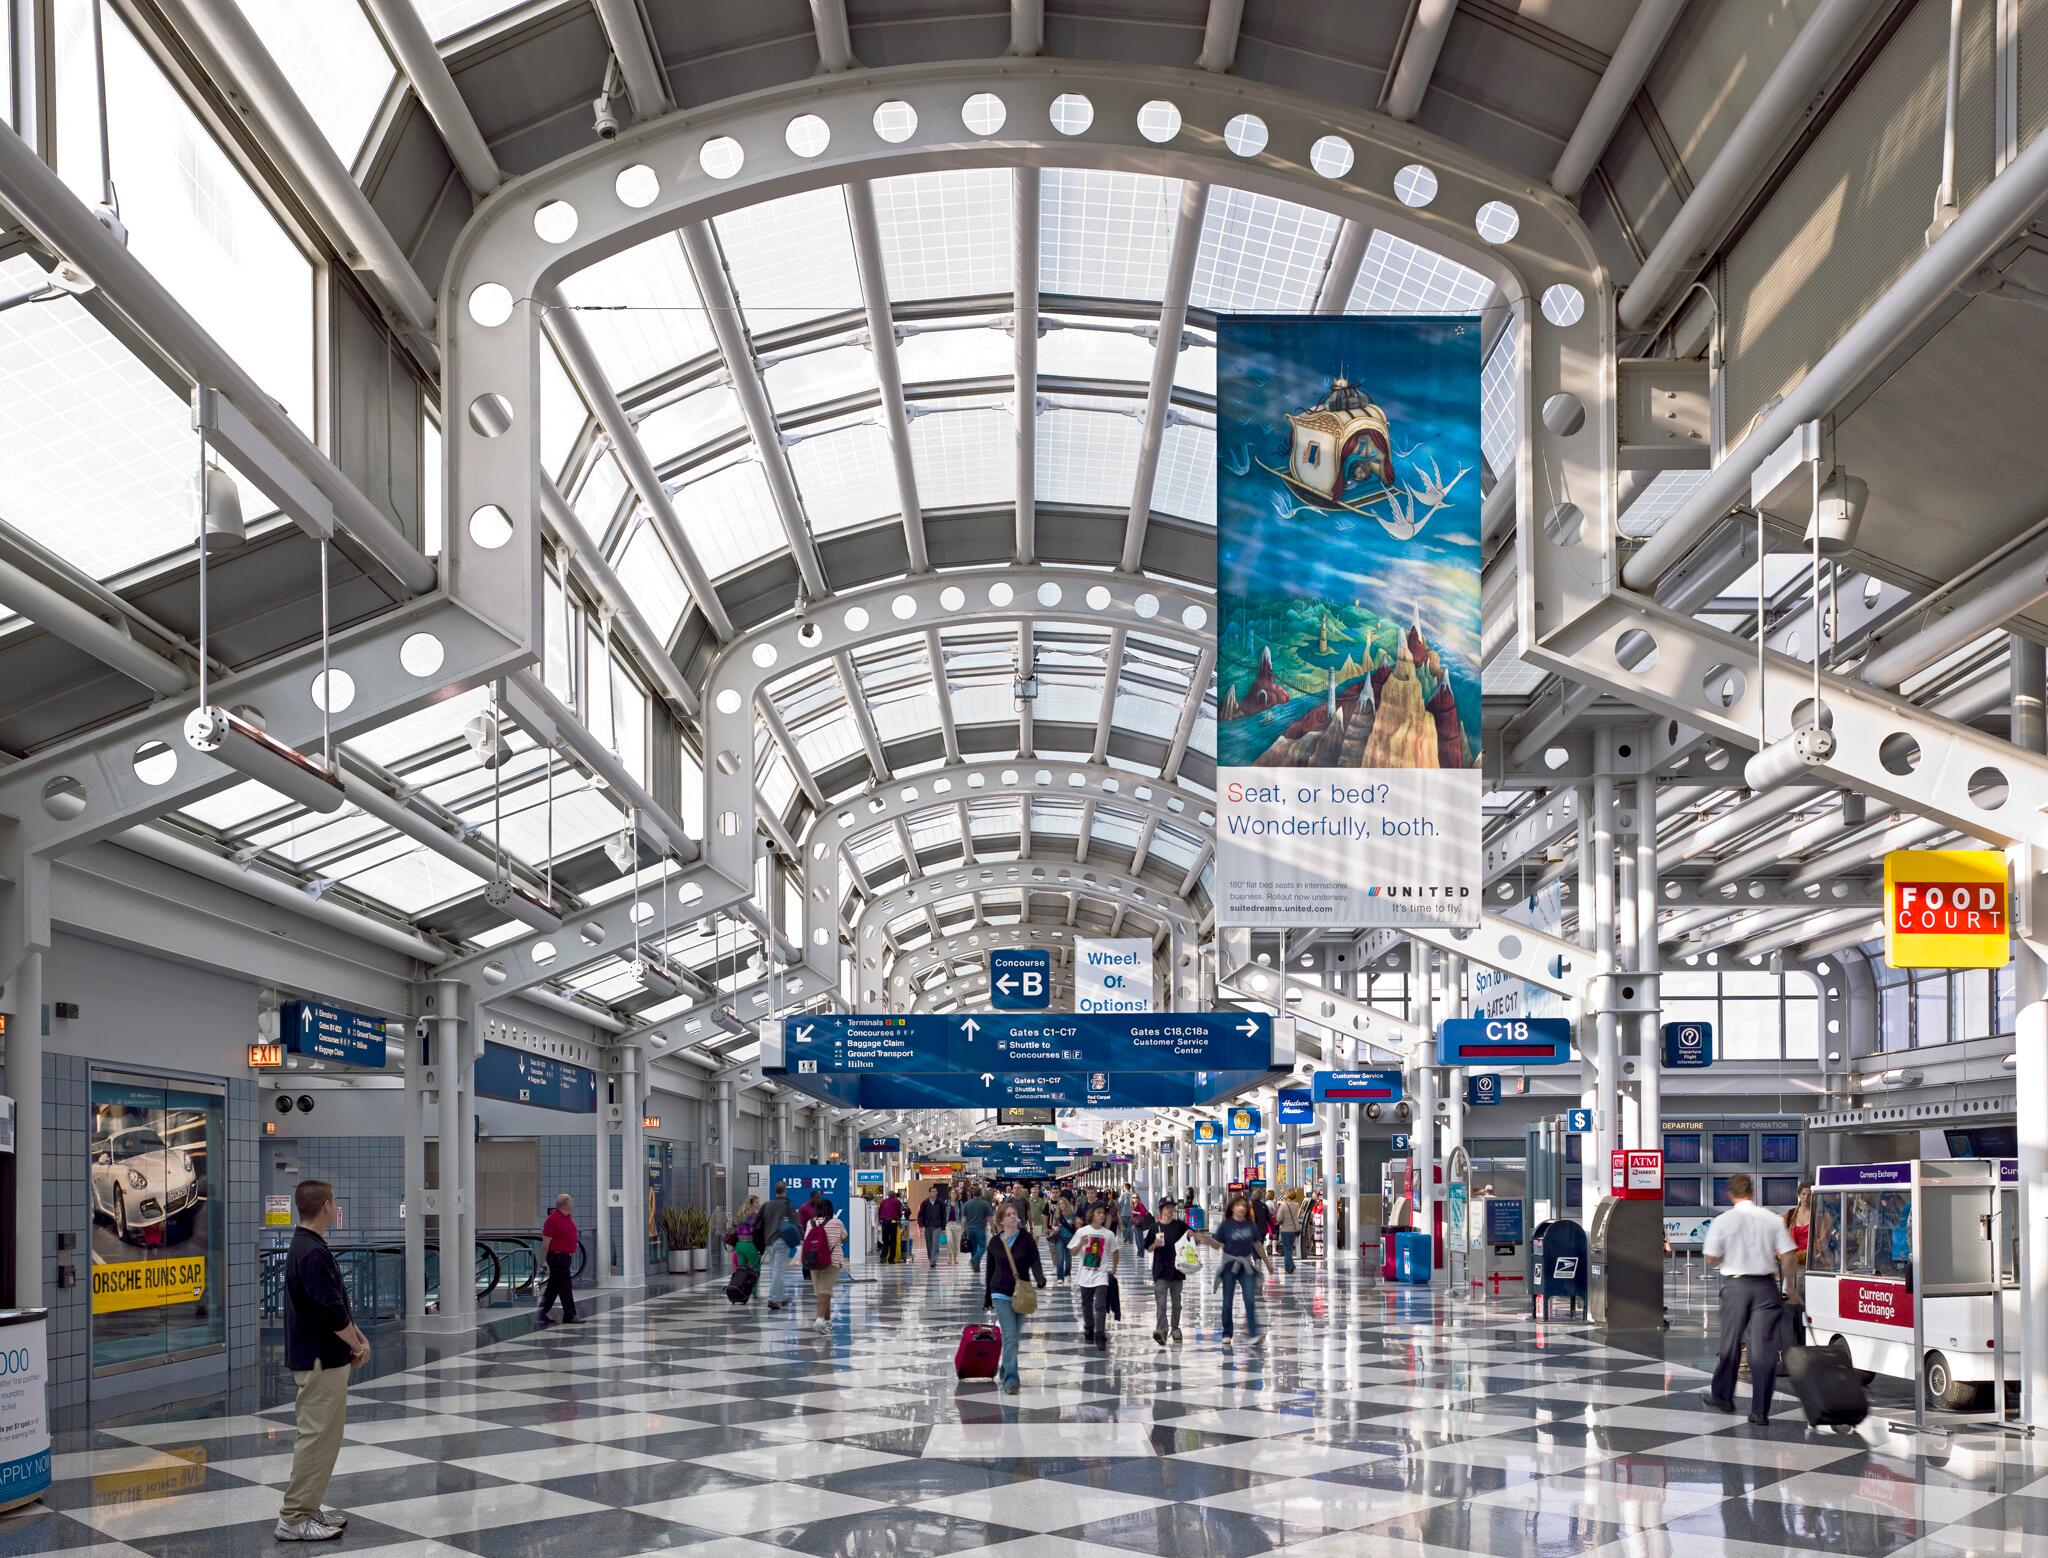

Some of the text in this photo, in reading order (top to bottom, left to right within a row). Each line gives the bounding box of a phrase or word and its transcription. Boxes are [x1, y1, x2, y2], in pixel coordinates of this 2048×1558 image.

[1228, 782, 1390, 806] Seat, or bed?
[1227, 815, 1440, 840] Wonderfully, both.
[1259, 881, 1274, 889] bed
[1304, 882, 1348, 890] international
[1388, 886, 1470, 898] UNITED
[1902, 887, 1996, 910] FOOD
[1230, 904, 1333, 913] suitedreams.united.com
[1392, 904, 1407, 912] It's
[1410, 904, 1432, 912] time
[1435, 904, 1445, 912] to
[1899, 911, 2001, 928] COURT
[995, 959, 1046, 967] Concourse
[1088, 952, 1142, 966] Wheel.
[1022, 972, 1043, 996] B
[1104, 976, 1126, 988] Of.
[1080, 998, 1148, 1014] Options!
[1487, 992, 1518, 1018] GATE C17
[848, 1018, 884, 1026] Terminals
[1010, 1028, 1077, 1037] Gates C1-C17
[1130, 1027, 1209, 1037] Gates C18,C18a
[1486, 1022, 1529, 1041] C18
[848, 1040, 882, 1048] Baggage
[1010, 1041, 1040, 1049] Shuttle
[1133, 1038, 1209, 1046] Customer Service
[251, 1046, 280, 1062] EXIT
[848, 1050, 914, 1058] Ground Transport
[848, 1060, 874, 1068] Hilton
[1662, 1122, 1704, 1130] DEPARTURE
[873, 1138, 886, 1146] C17
[1632, 1158, 1656, 1166] ATM
[1860, 1170, 1898, 1180] Currency Exchange
[145, 1266, 177, 1289] RUNS
[180, 1264, 202, 1285] SAP.
[1859, 1286, 1894, 1305] Currency
[1858, 1302, 1895, 1320] Exchange
